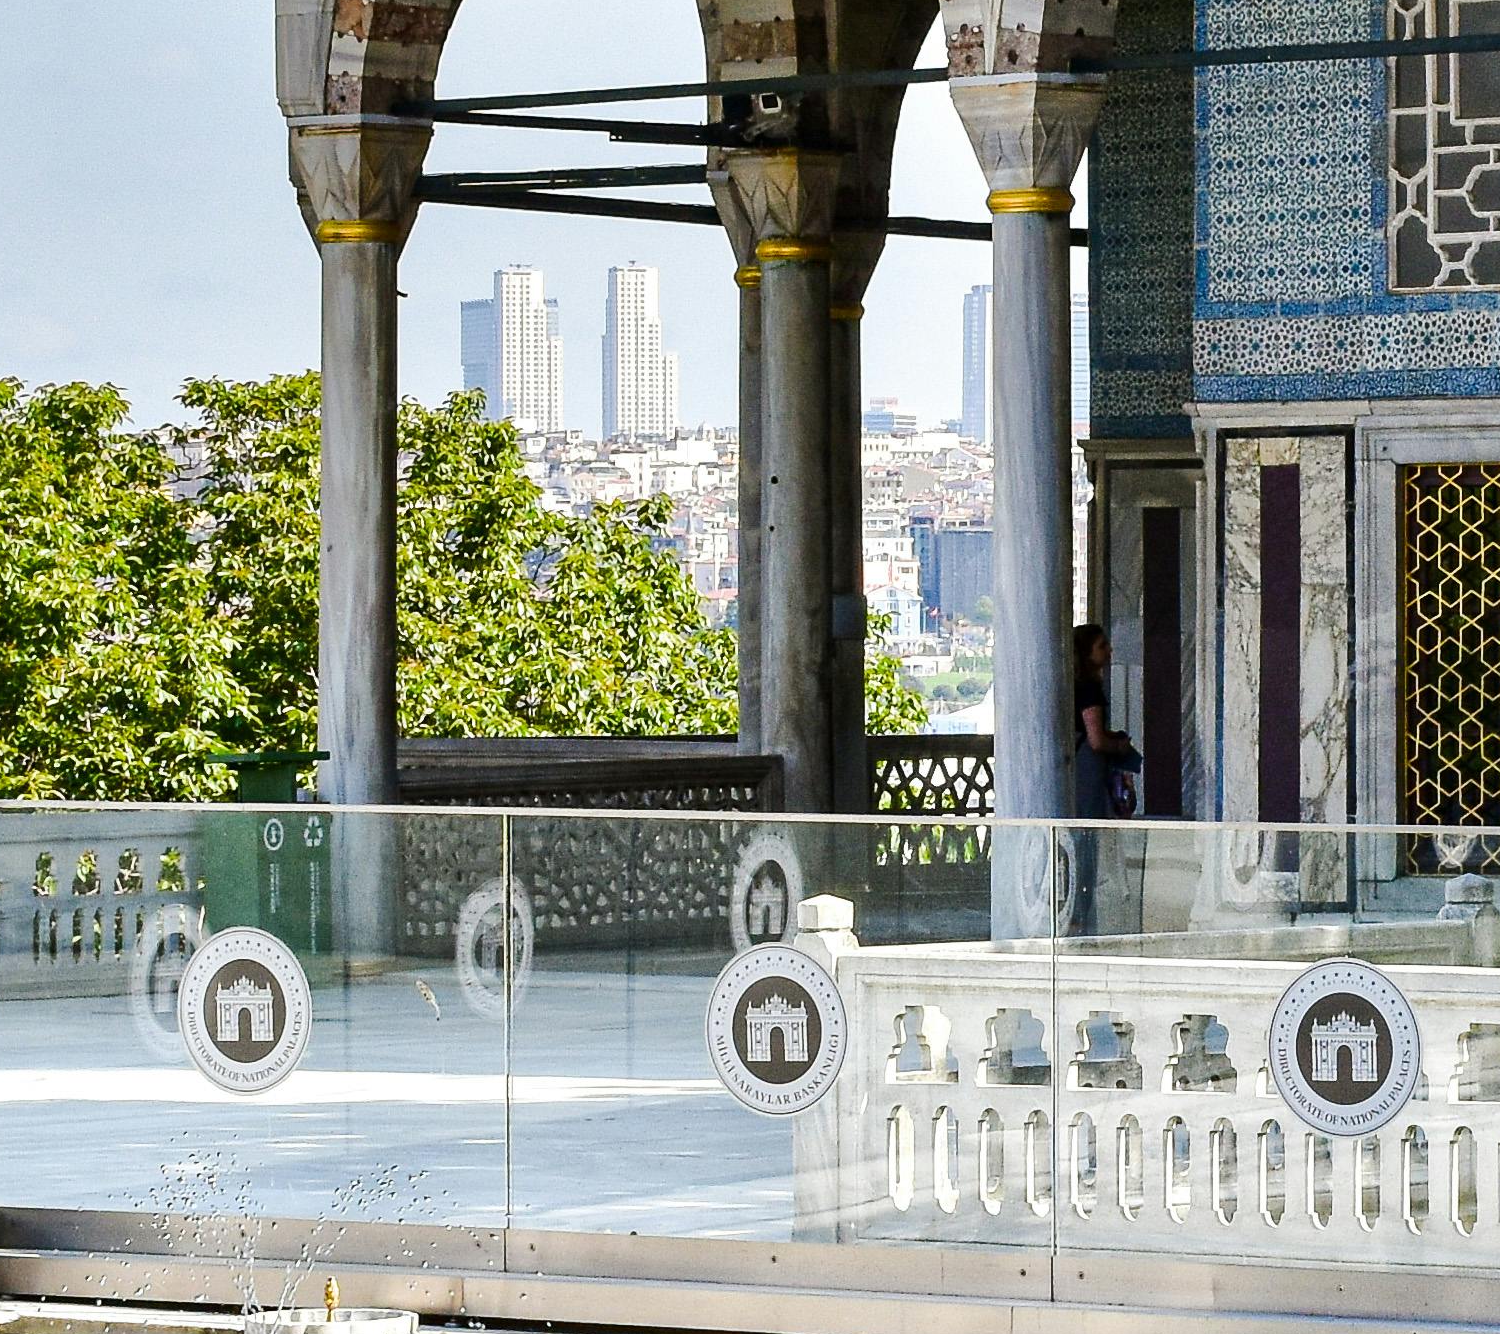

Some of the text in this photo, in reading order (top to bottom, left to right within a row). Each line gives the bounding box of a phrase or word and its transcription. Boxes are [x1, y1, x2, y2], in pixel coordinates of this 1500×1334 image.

[1278, 1048, 1411, 1126] DIRECTORATE OF NATIONAL PALACES
